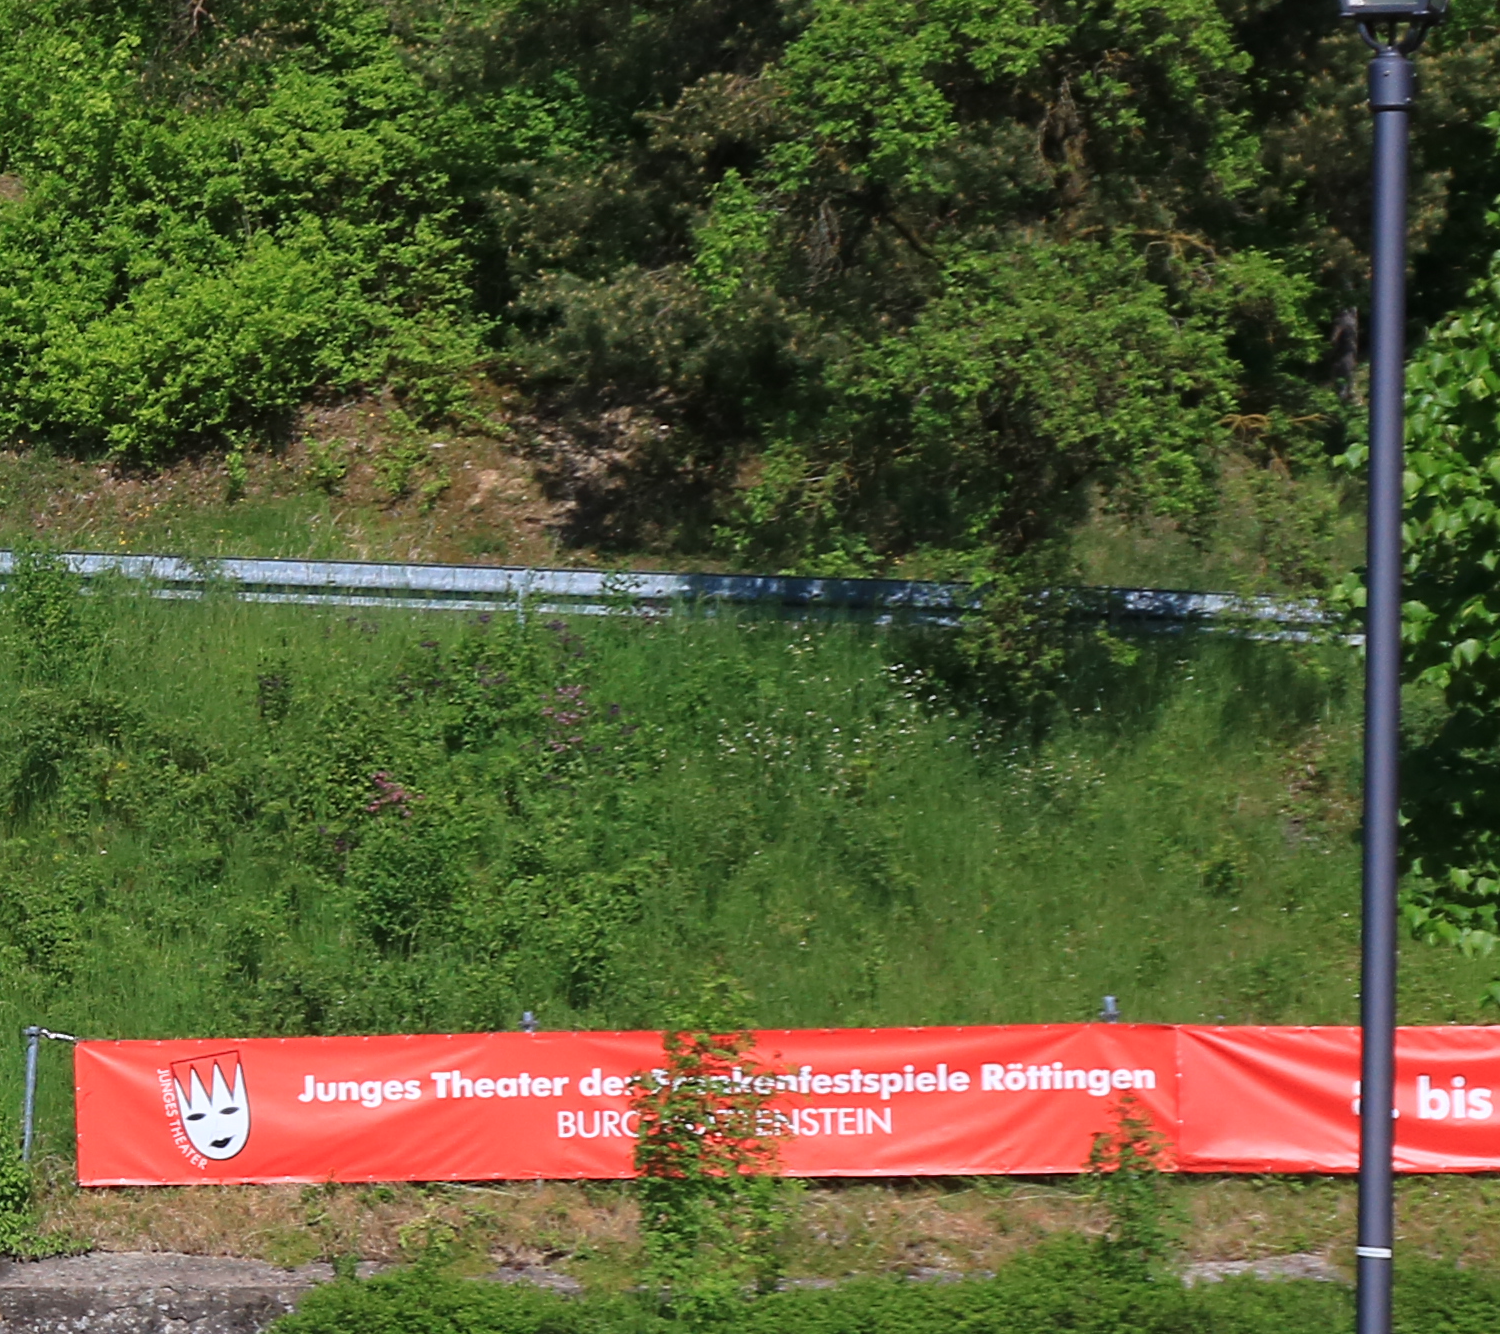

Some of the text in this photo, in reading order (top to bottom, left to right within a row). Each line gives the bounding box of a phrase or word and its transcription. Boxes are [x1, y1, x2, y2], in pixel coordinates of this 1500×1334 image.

[298, 1074, 422, 1108] Junges
[430, 1070, 570, 1099] Theater
[980, 1062, 1156, 1096] Röttingen
[1416, 1075, 1493, 1121] bis
[157, 1068, 208, 1170] JUNGES THEATER
